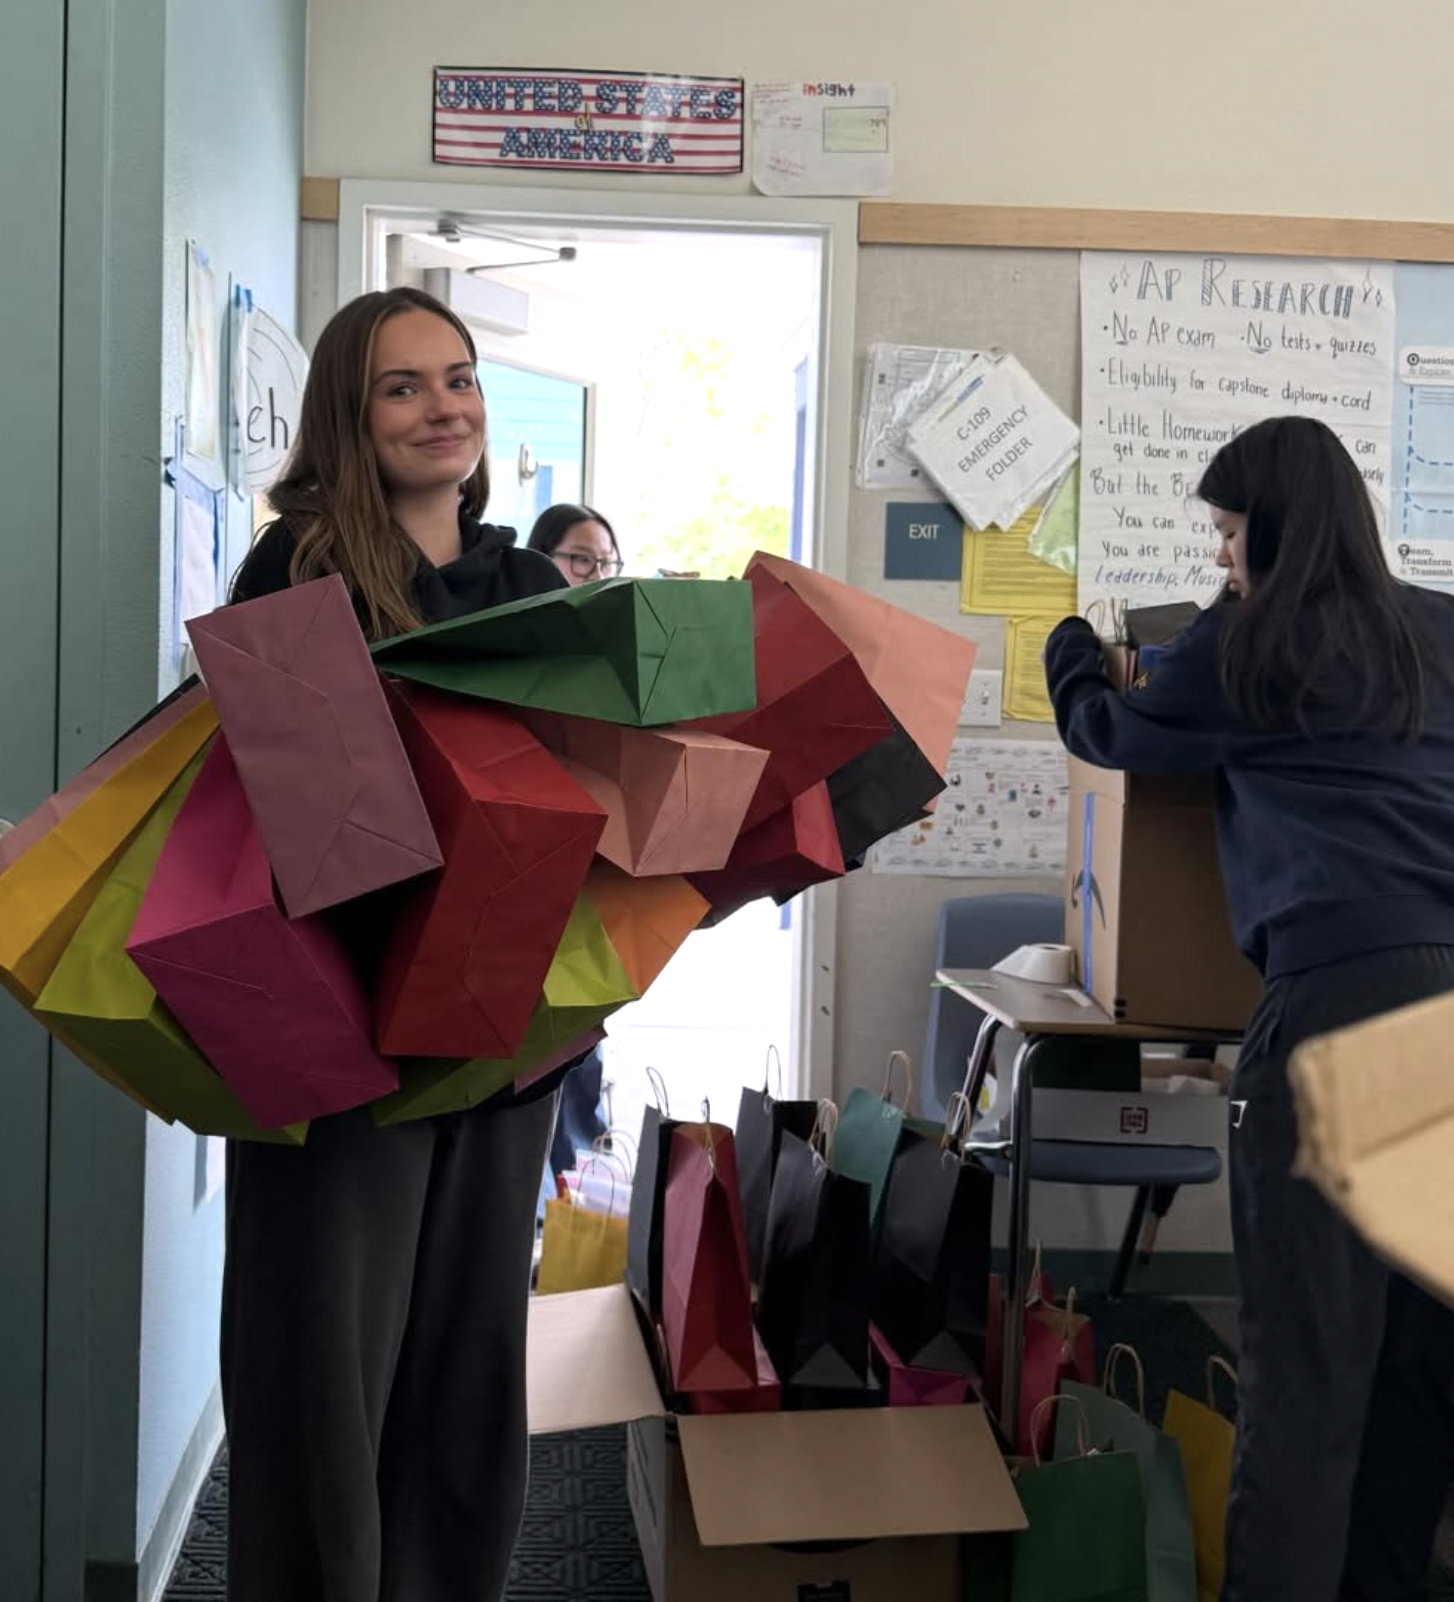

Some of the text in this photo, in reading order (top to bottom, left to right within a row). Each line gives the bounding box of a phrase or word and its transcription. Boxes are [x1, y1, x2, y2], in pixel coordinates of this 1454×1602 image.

[438, 77, 583, 112] UNITED
[595, 82, 737, 119] STATES
[499, 127, 675, 163] AMERICA
[1113, 310, 1216, 349] No AP exam
[1246, 320, 1273, 353] No
[1281, 324, 1311, 351] tests
[1330, 336, 1377, 360] quizzes
[1108, 357, 1177, 395] Eligibility
[1190, 369, 1205, 391] for
[1218, 377, 1269, 398] capstone
[1341, 389, 1372, 411] cord
[956, 406, 992, 442] C-109
[957, 404, 1030, 474] EMERGENCY
[1108, 405, 1150, 438] Little
[985, 436, 1034, 483] FOLDER
[1113, 441, 1134, 463] get
[1143, 444, 1171, 459] done
[1176, 448, 1188, 460] in
[1355, 438, 1376, 455] can
[1090, 467, 1123, 496] But
[1136, 470, 1159, 496] the
[909, 524, 939, 540] EXIT
[1112, 505, 1143, 529] You
[1152, 516, 1175, 531] can
[1137, 543, 1161, 558] are
